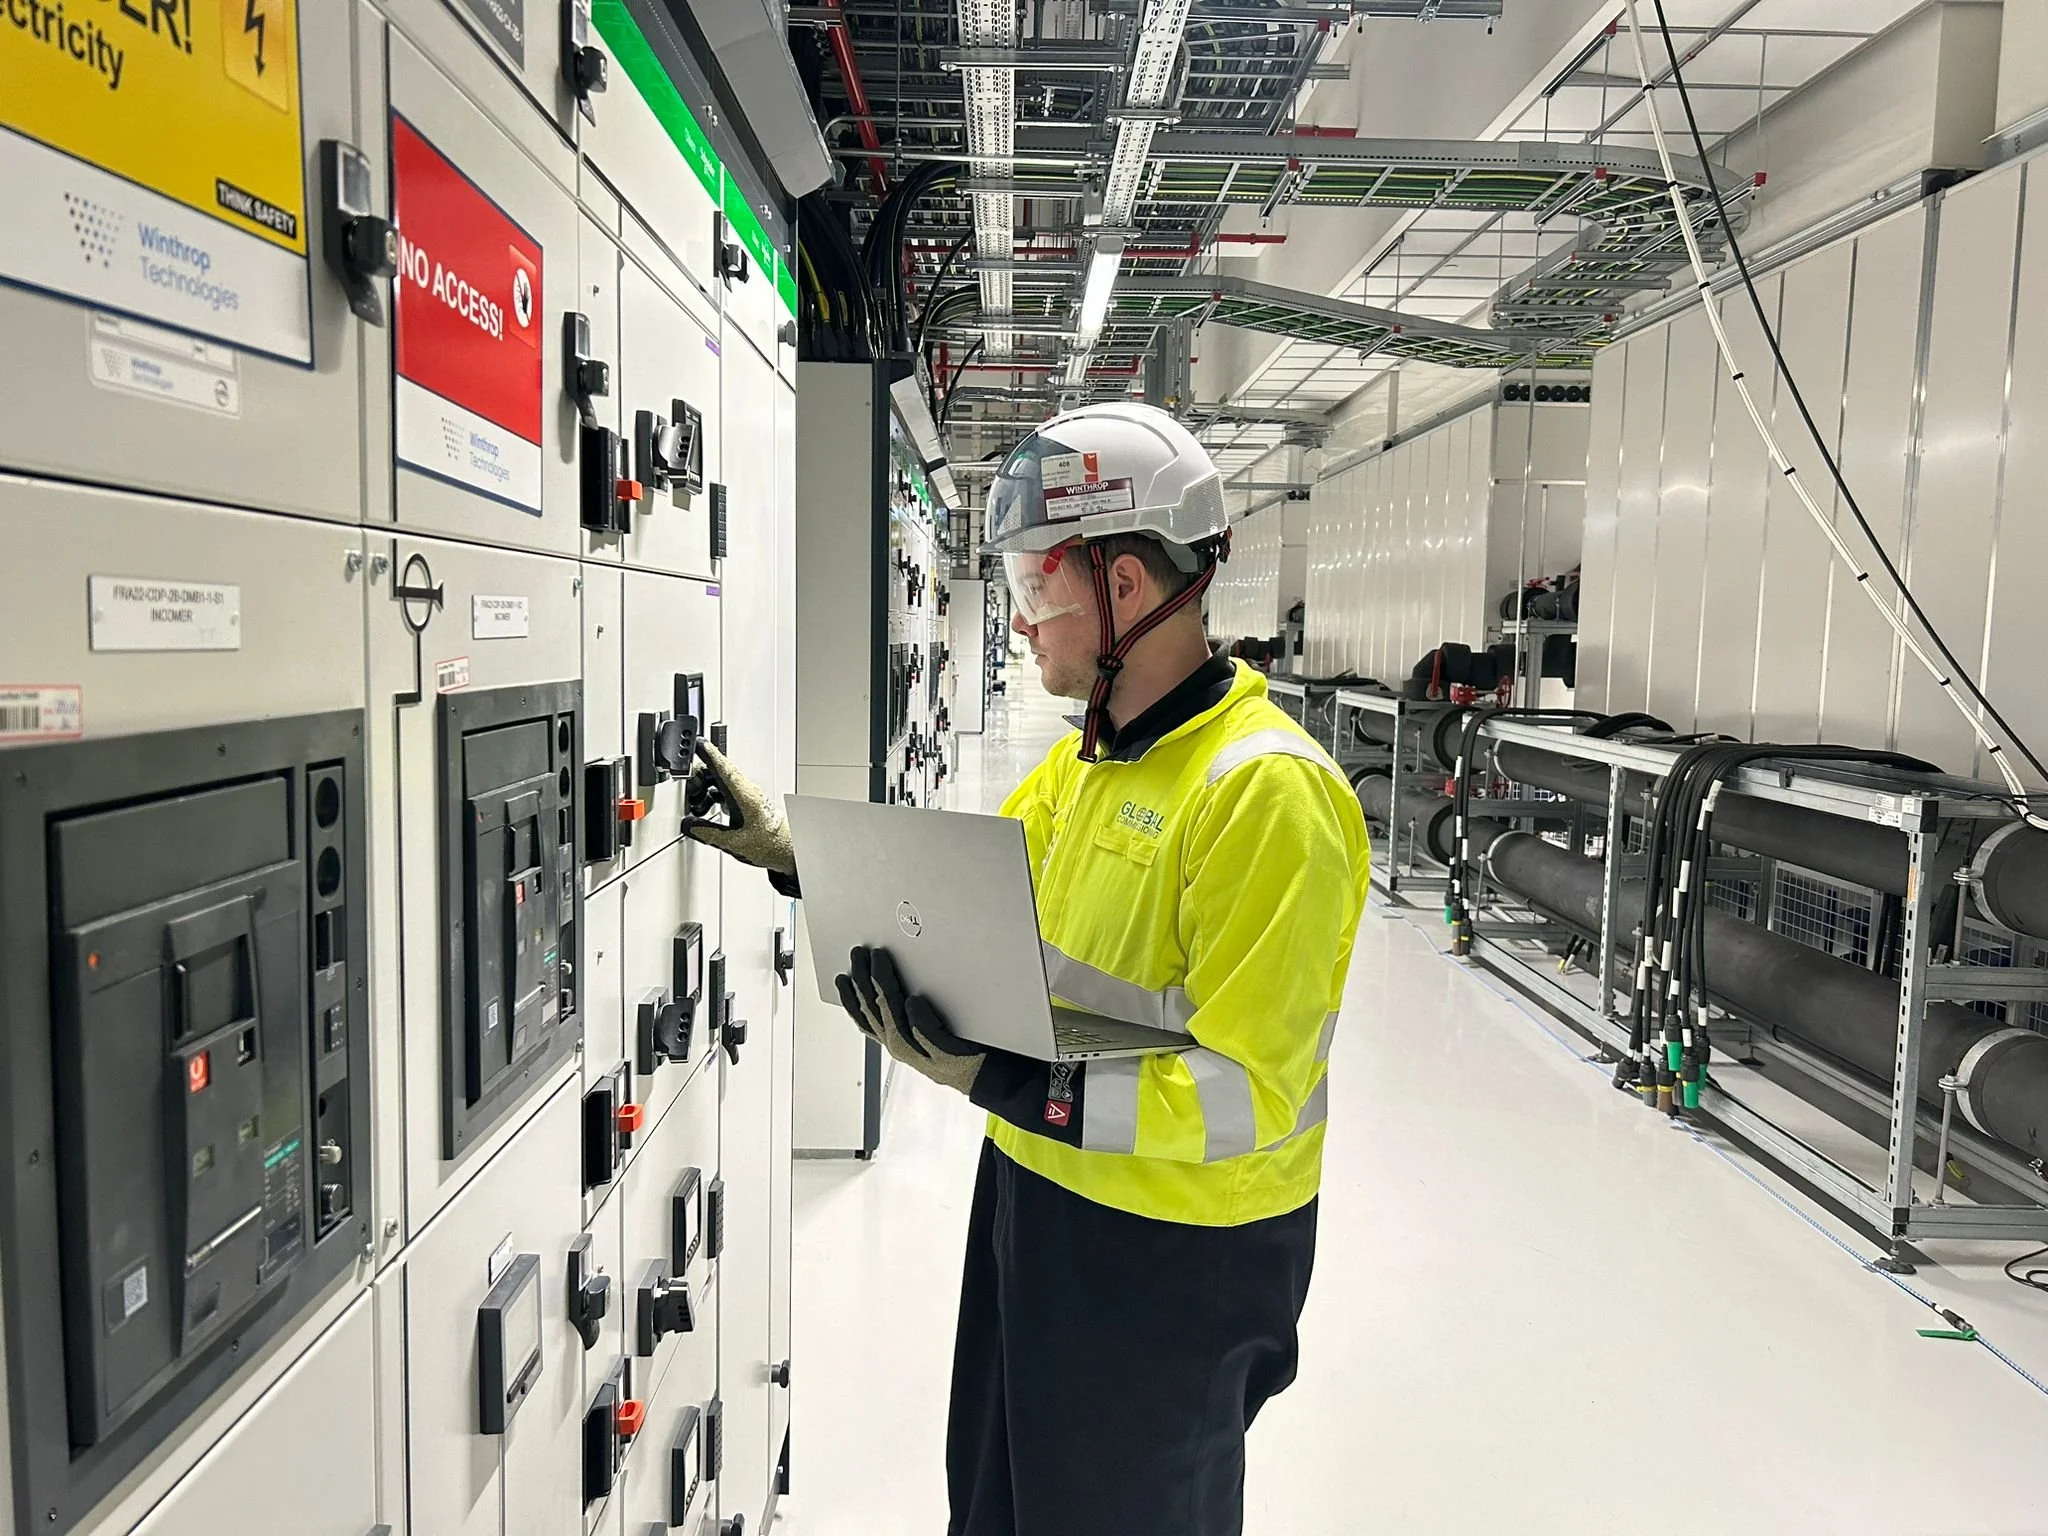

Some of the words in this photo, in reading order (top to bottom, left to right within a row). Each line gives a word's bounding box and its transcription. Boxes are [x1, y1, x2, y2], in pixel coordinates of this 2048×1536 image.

[0, 0, 123, 91] ctricity
[218, 183, 253, 216] THINK
[253, 201, 295, 236] SAFETY
[138, 222, 211, 275] Winthrop
[140, 255, 239, 311] Technologies
[401, 235, 429, 289] NO
[432, 262, 503, 342] ACCESS!
[469, 431, 499, 461] Winthrop
[1065, 481, 1109, 495] WINTHROP
[152, 608, 194, 623] INCOMER
[1121, 801, 1165, 832] GLOBAL
